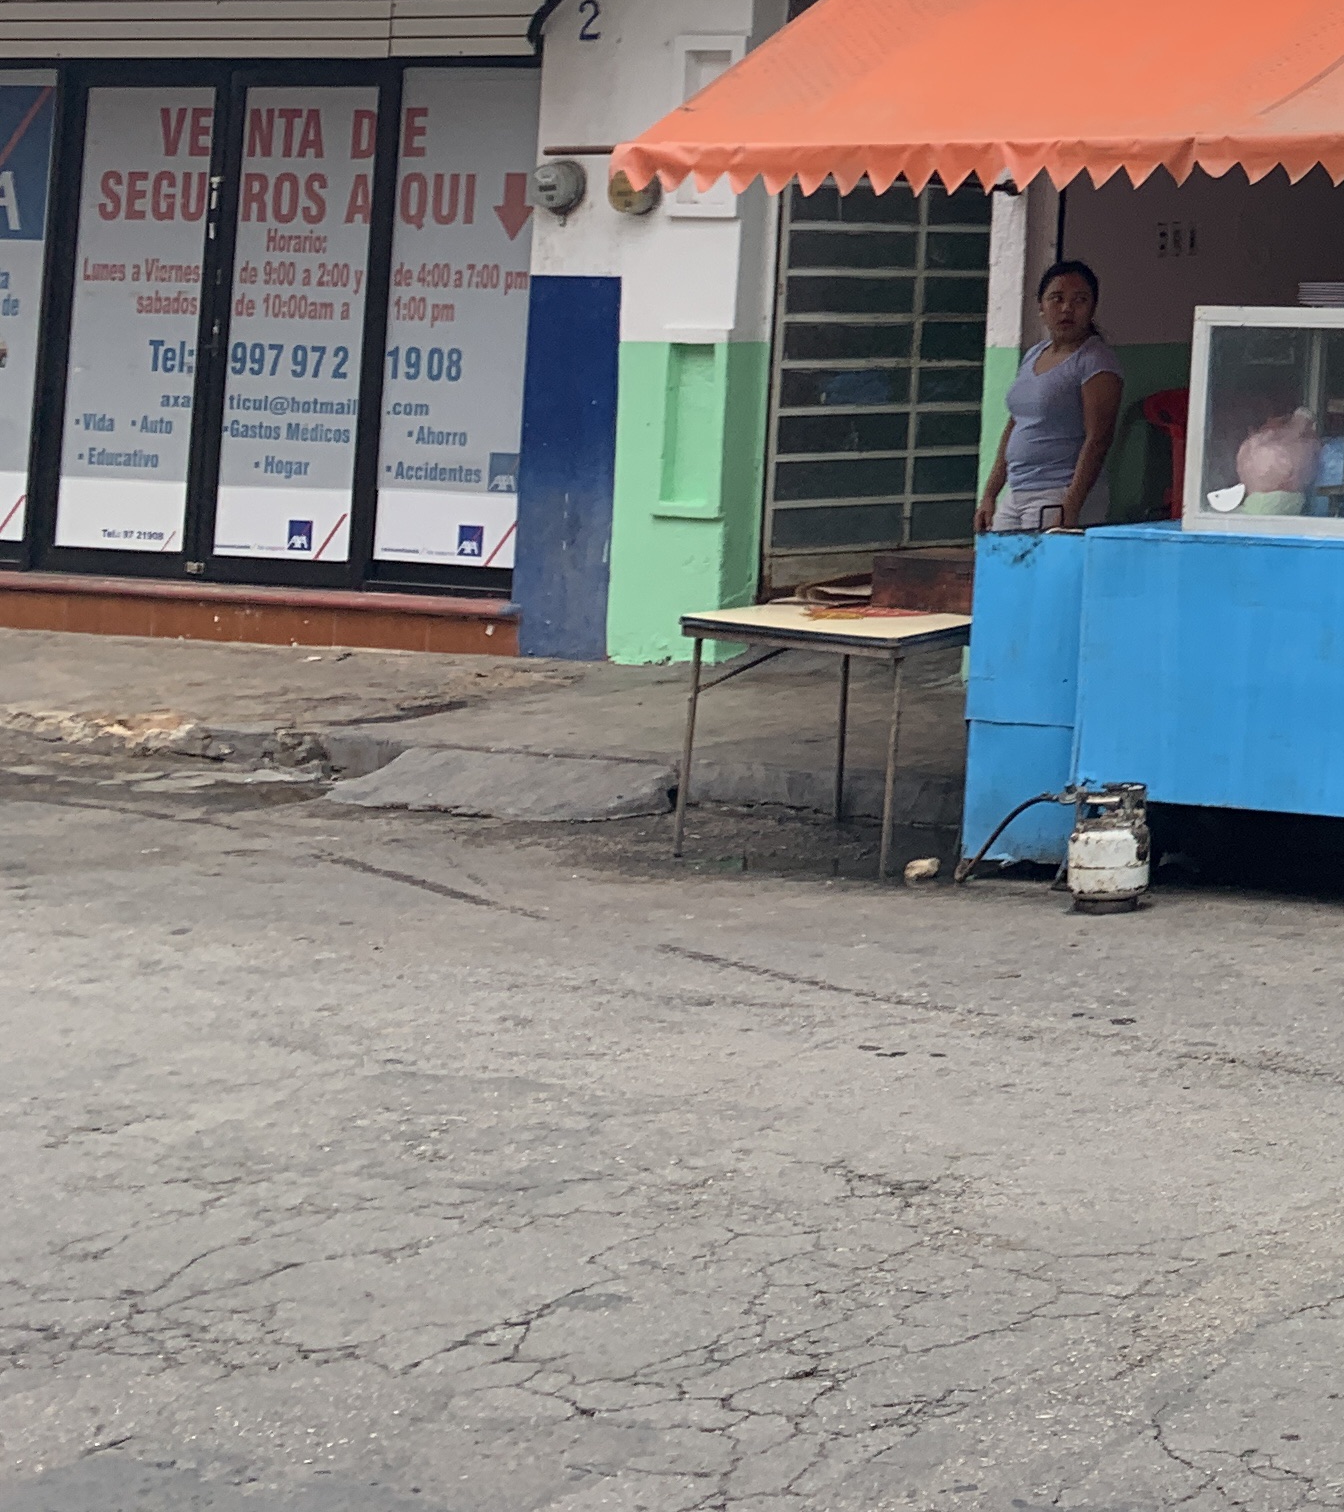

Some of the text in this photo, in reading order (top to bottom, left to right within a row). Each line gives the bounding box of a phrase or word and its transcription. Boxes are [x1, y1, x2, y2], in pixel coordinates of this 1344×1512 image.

[578, 0, 602, 41] 2
[131, 263, 141, 282] a
[239, 260, 258, 285] de
[263, 260, 297, 287] 9:00
[302, 268, 311, 287] a
[316, 262, 350, 288] 2:00
[353, 268, 364, 295] y
[393, 261, 413, 288] de
[416, 262, 450, 289] 4:00
[453, 268, 463, 289] a
[466, 263, 499, 289] 7:00
[504, 270, 529, 296] pm
[234, 293, 255, 317] de
[341, 301, 350, 321] a
[430, 301, 455, 329] pm
[148, 338, 195, 374] Tel:
[229, 341, 284, 377] 997
[82, 412, 115, 432] Vida
[139, 415, 173, 435] Auto
[229, 419, 281, 440] Gastos
[415, 425, 468, 447] Ahorro
[87, 447, 482, 484] Educativo Hogar Accidentes
